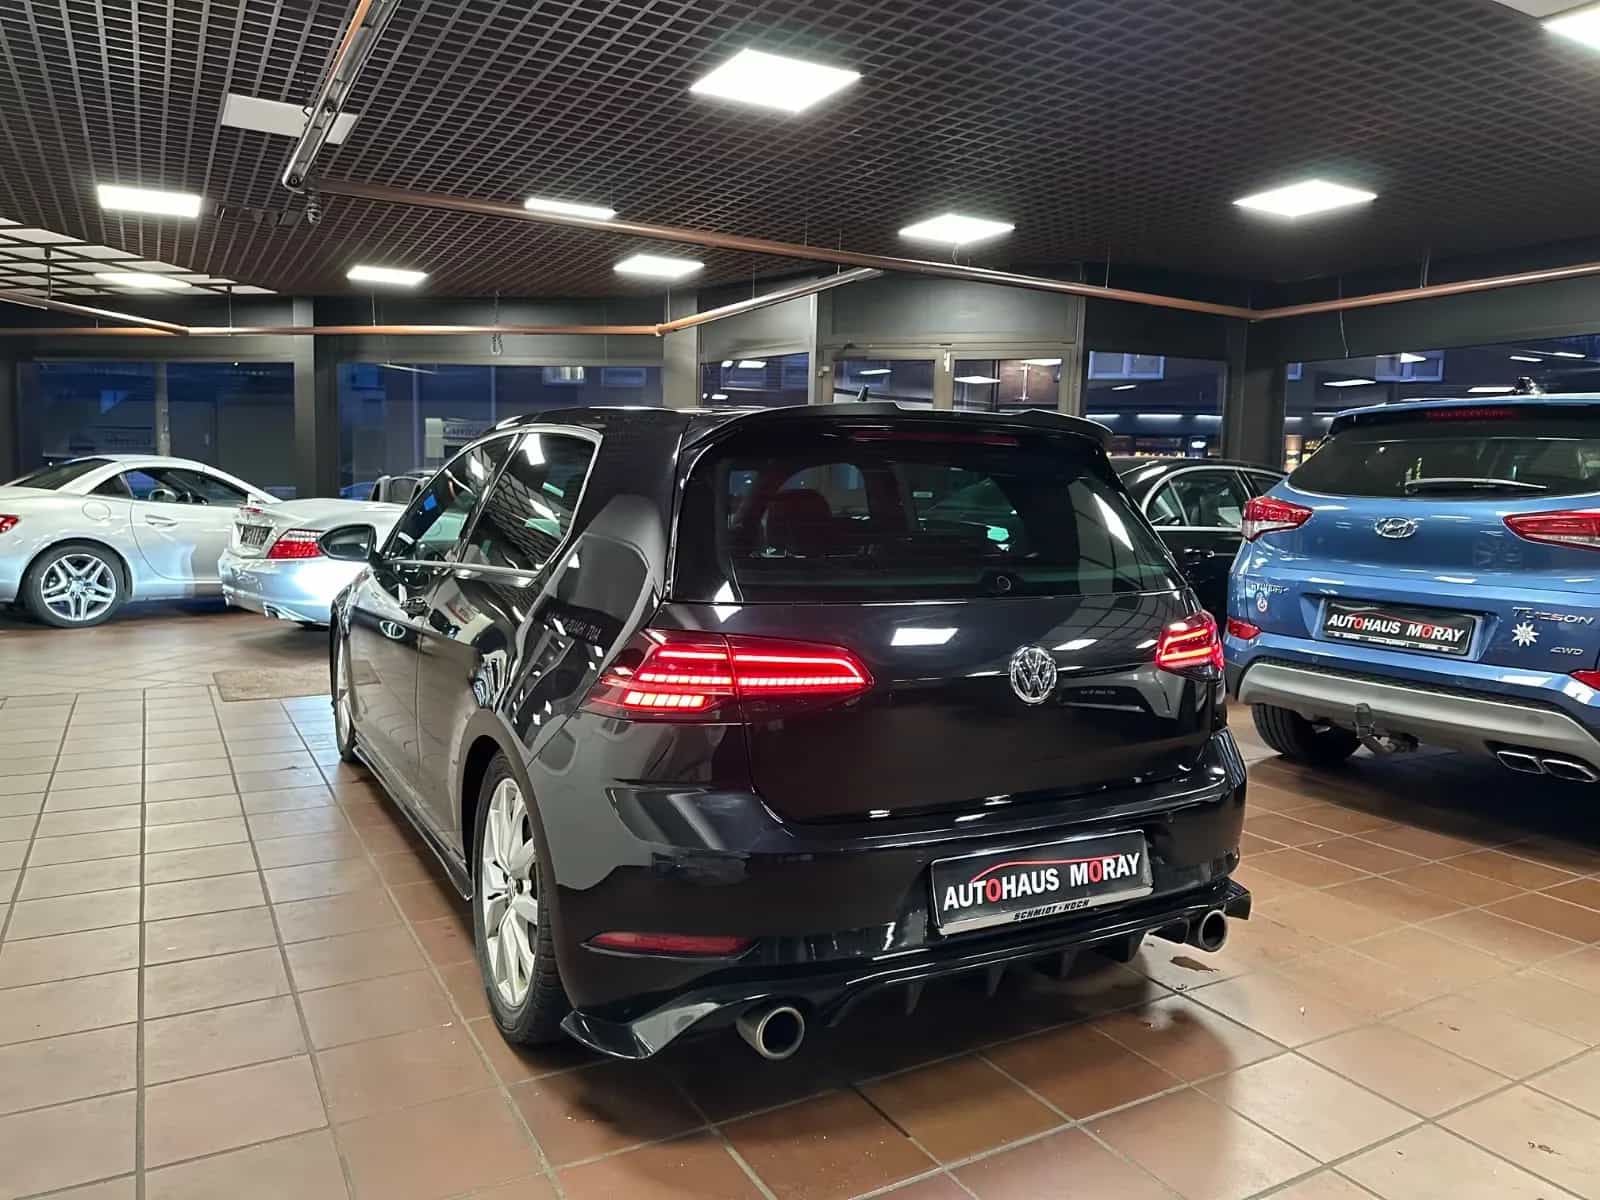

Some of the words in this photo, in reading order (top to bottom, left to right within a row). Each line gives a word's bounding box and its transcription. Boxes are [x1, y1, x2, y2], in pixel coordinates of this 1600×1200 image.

[1327, 614, 1401, 634] AUTOHAUS
[1406, 623, 1465, 643] MORAY
[943, 868, 1060, 912] AUTOHAUS
[1070, 852, 1140, 887] MORAY
